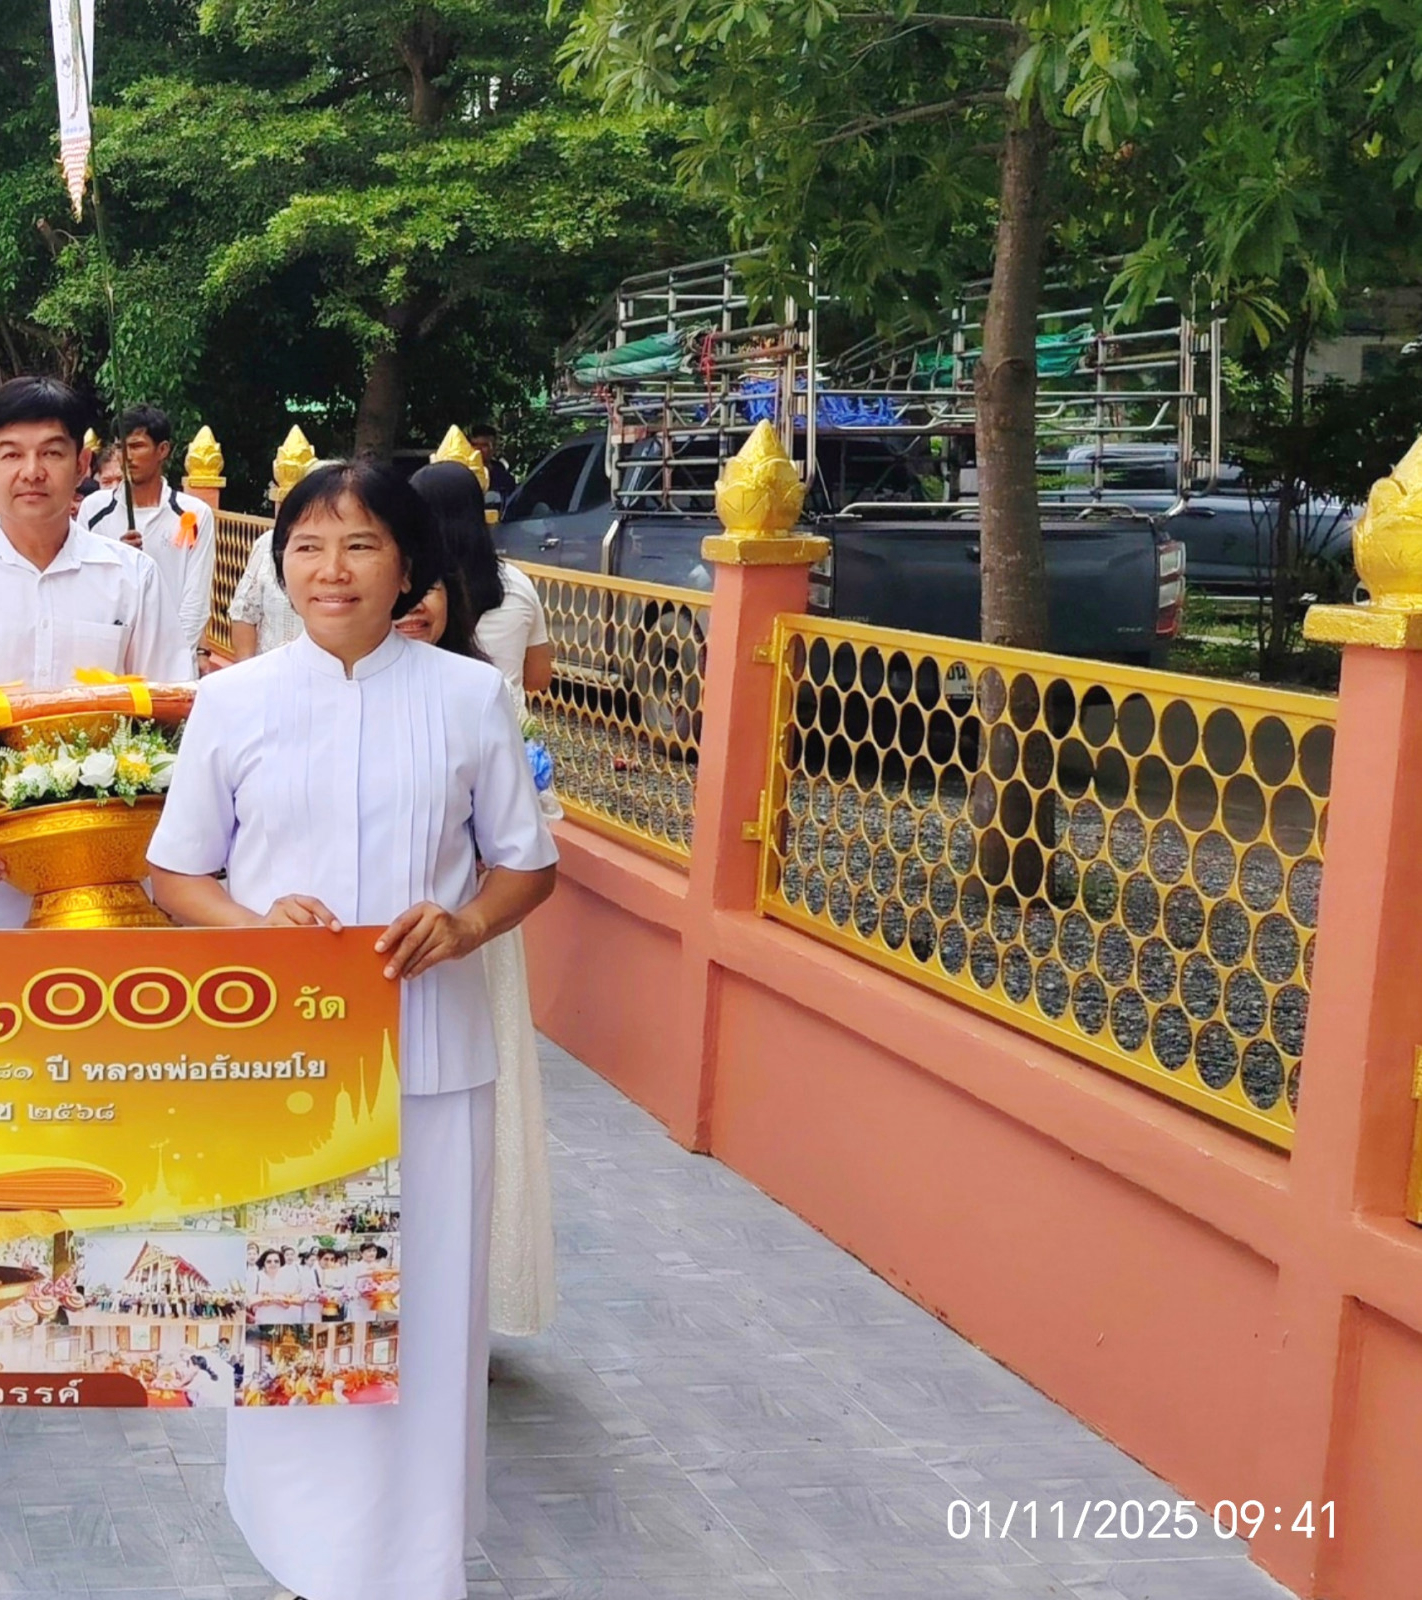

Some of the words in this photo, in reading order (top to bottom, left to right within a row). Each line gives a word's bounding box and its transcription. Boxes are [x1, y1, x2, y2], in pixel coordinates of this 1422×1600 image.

[293, 985, 347, 1020] วัด
[47, 1055, 70, 1082] ปี
[81, 1052, 327, 1082] หลวงพ่อธัมมชโย
[27, 1101, 116, 1122] ๒๕๖๘
